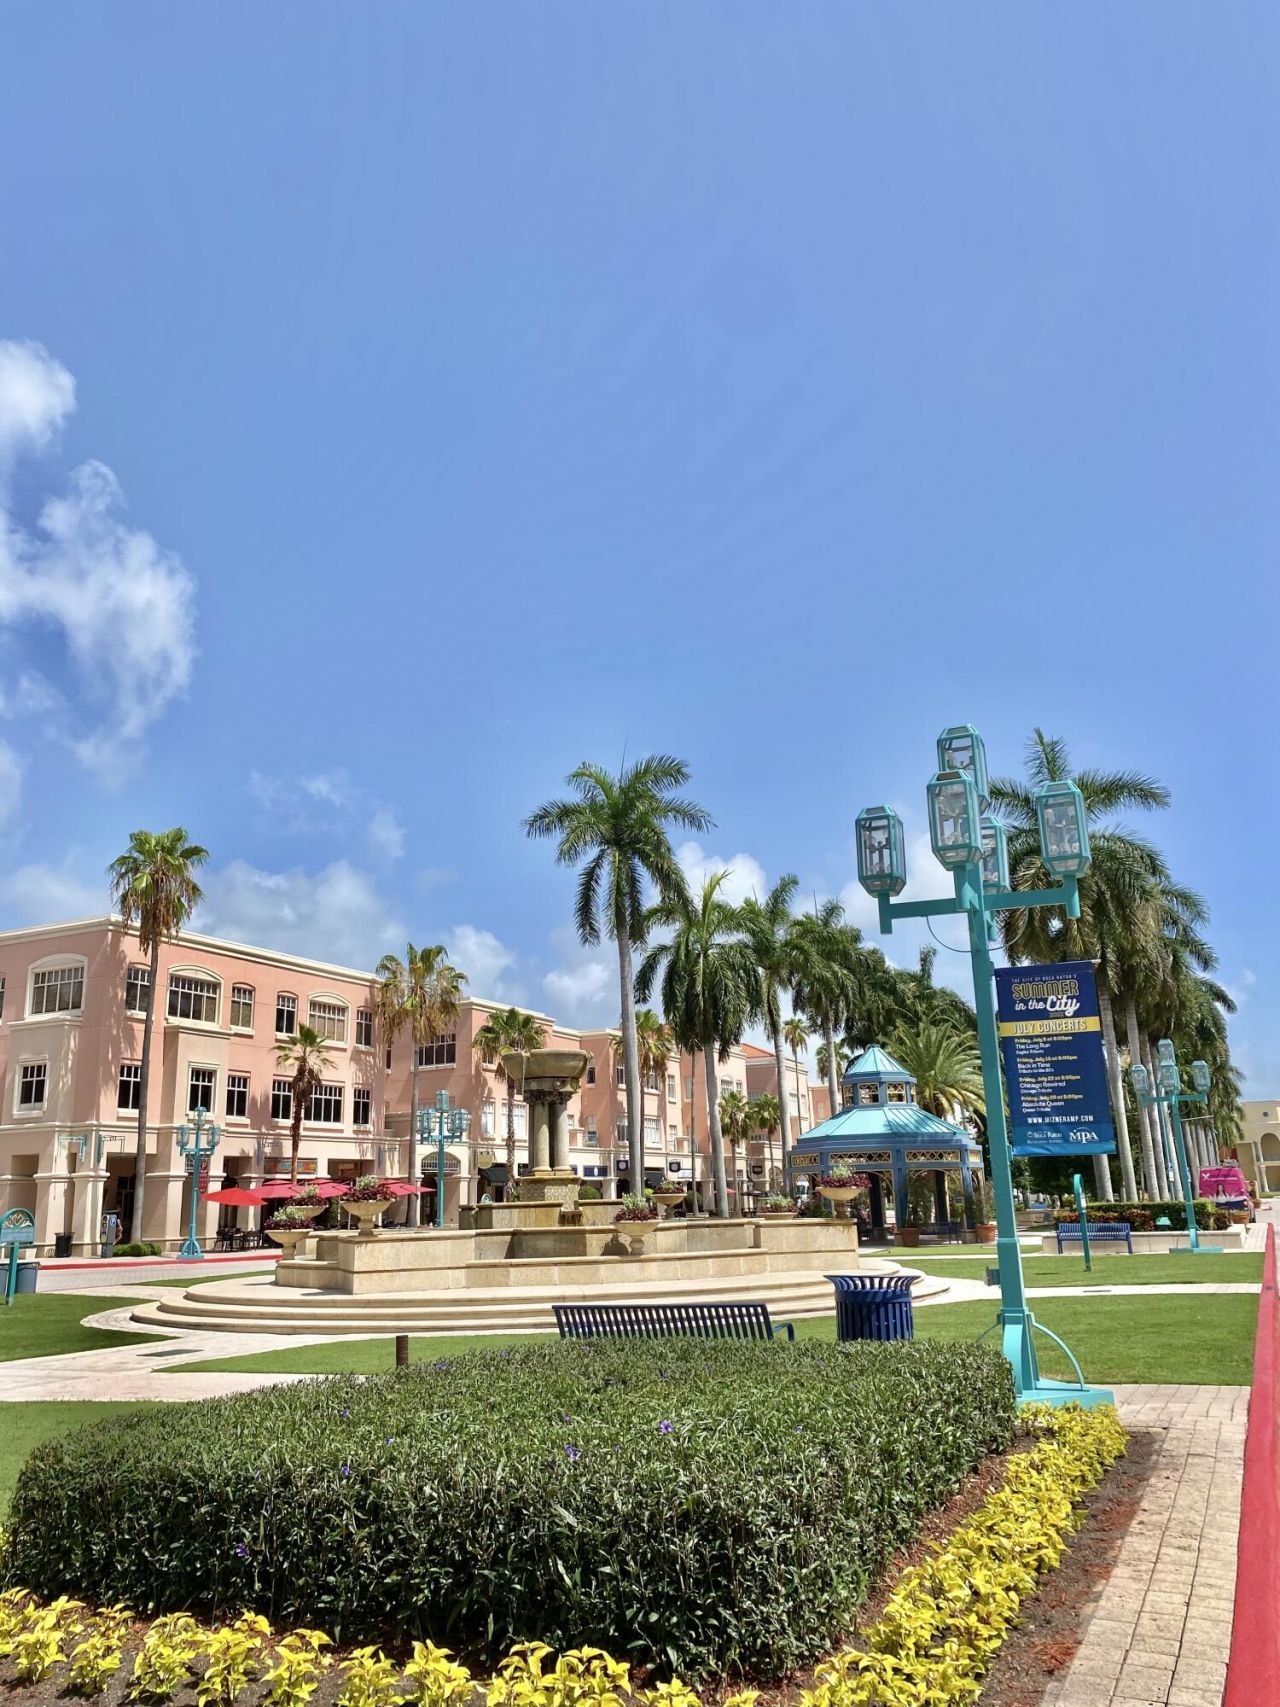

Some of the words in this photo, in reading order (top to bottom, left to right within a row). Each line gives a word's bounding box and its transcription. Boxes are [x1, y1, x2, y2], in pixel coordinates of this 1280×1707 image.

[1013, 980, 1079, 999] SUMMER
[1015, 1000, 1027, 1010] in
[1028, 1000, 1045, 1009] the
[1046, 995, 1080, 1016] City
[1013, 1021, 1035, 1034] JULY
[1038, 1020, 1087, 1033] CONCERTS
[1028, 1115, 1094, 1123] WWW.MIZNERAMP.COM
[1069, 1131, 1099, 1143] MPA
